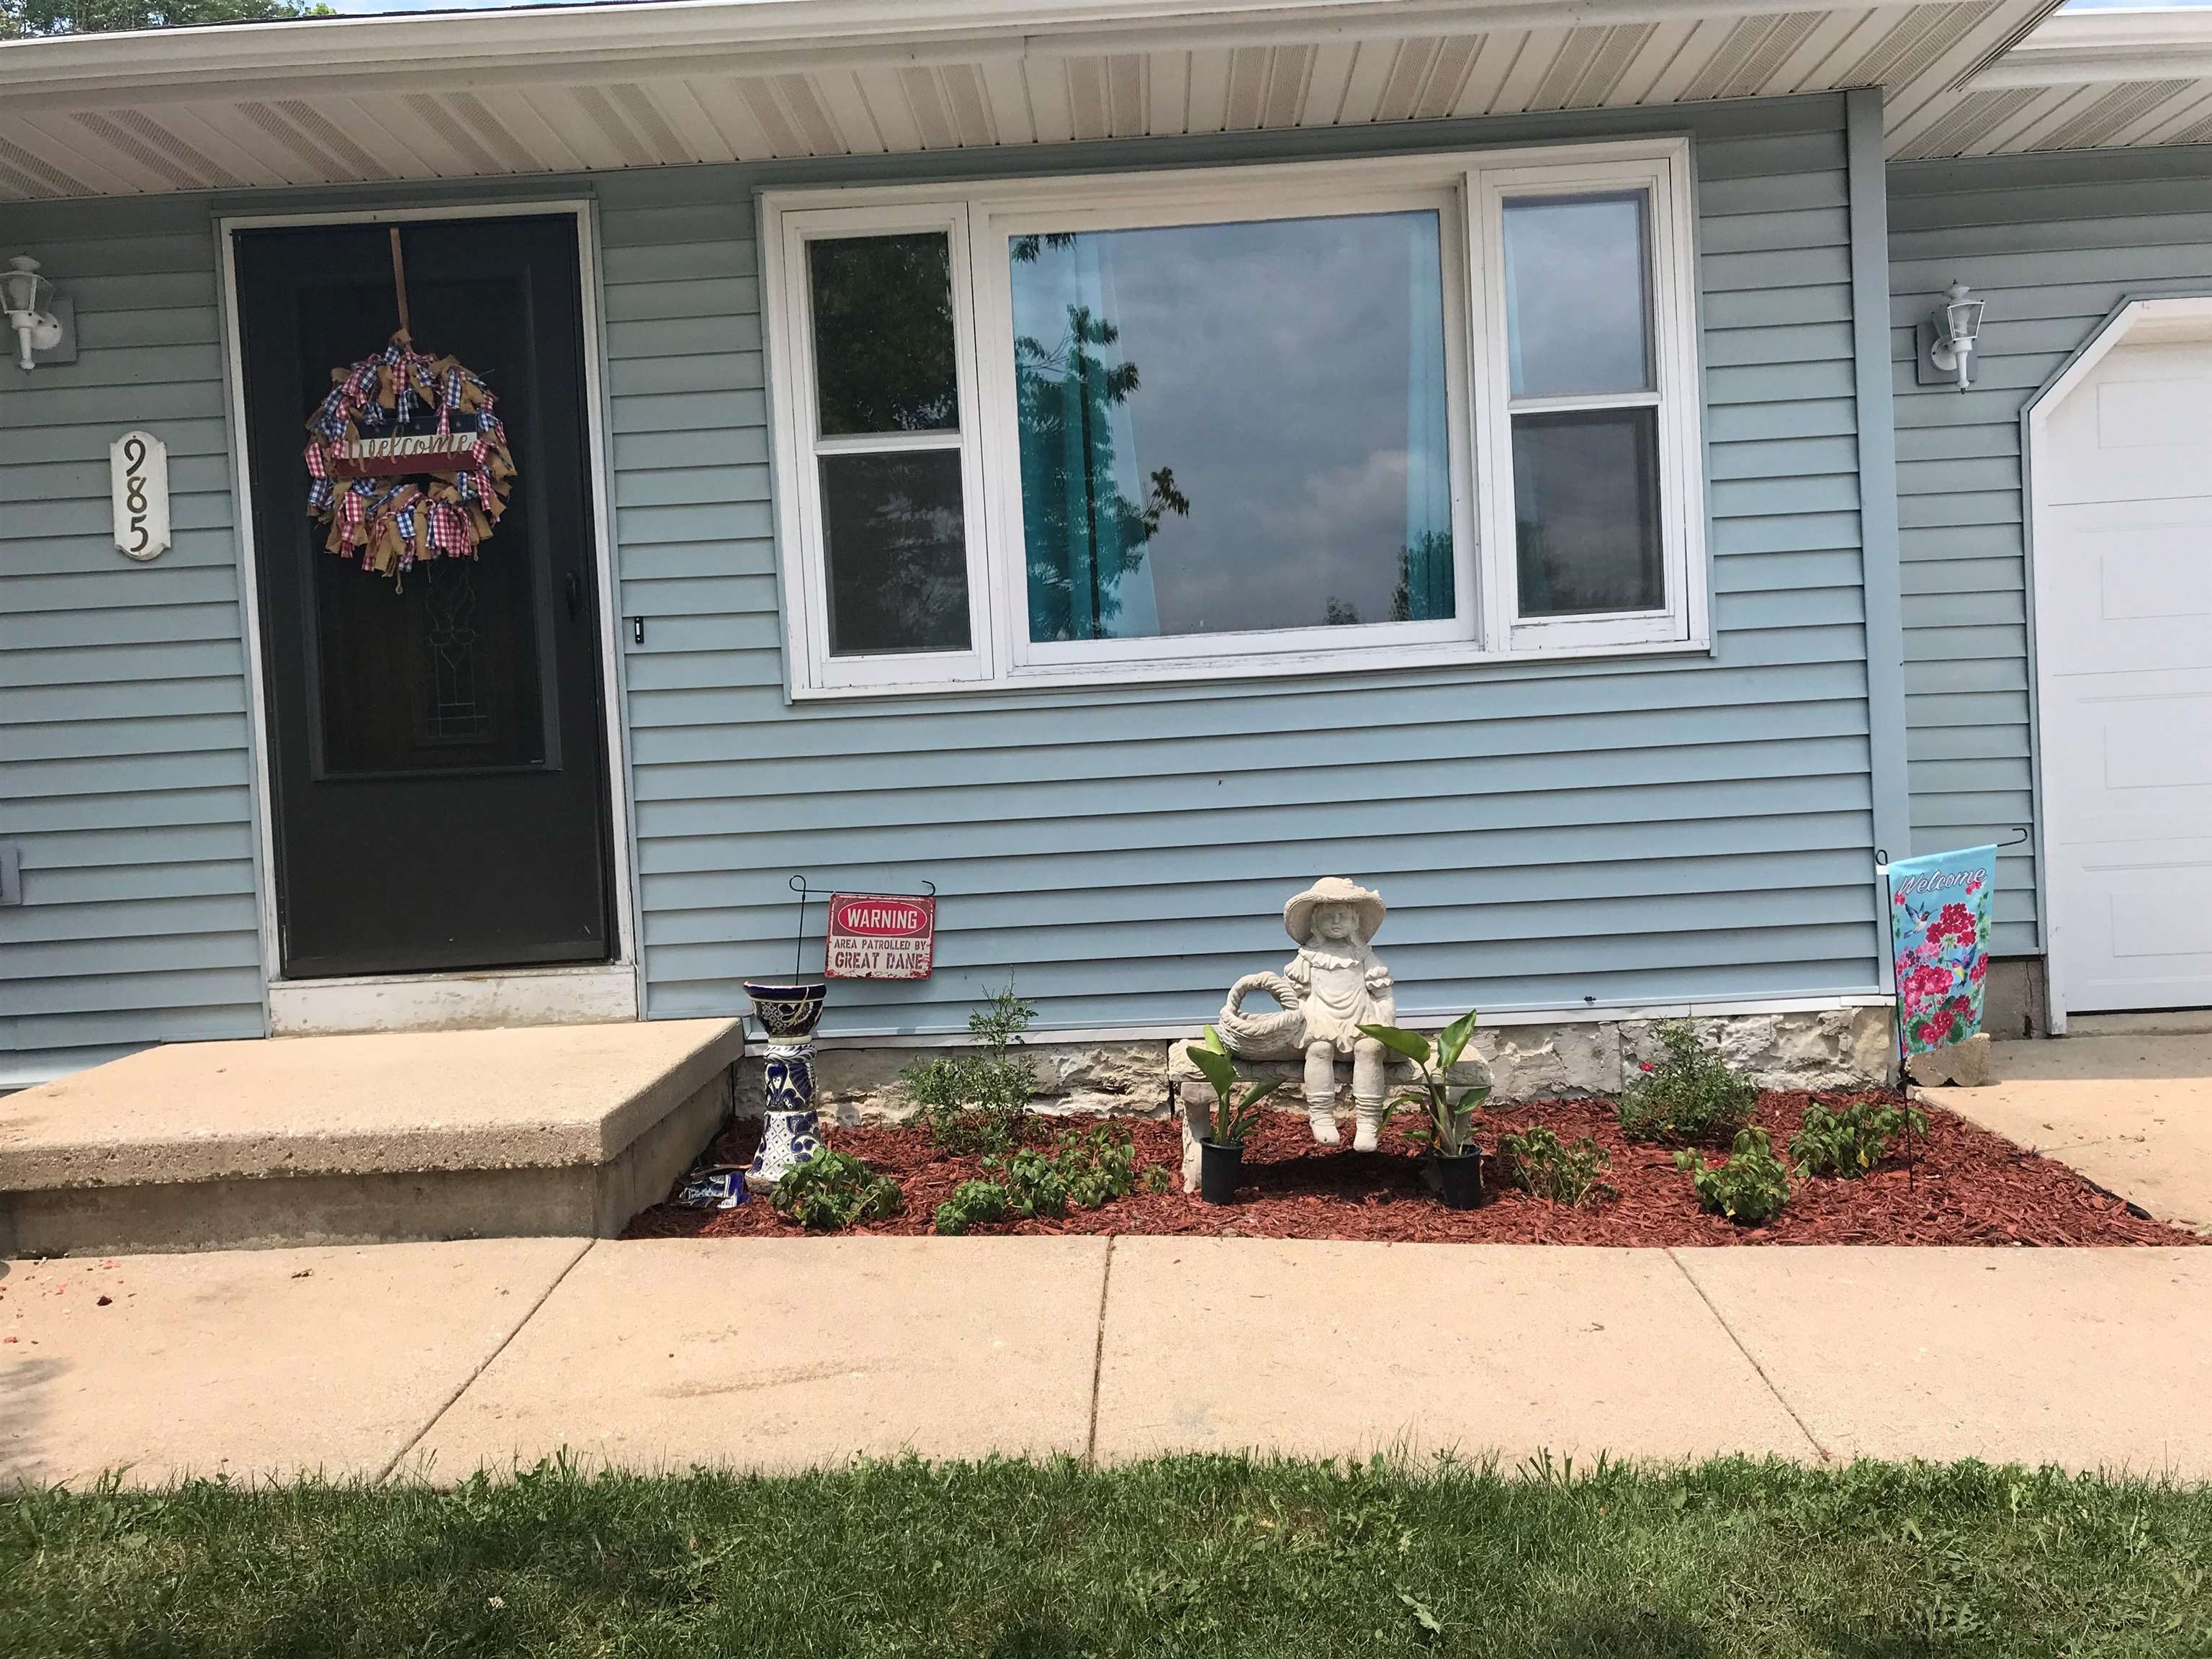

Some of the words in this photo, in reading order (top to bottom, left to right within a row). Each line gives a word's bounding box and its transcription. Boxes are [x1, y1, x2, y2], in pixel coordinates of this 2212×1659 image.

[124, 438, 149, 552] 985
[1898, 868, 1988, 896] Welcome
[848, 909, 917, 929] WARNING
[834, 939, 858, 949] AREA
[862, 939, 911, 950] PATROLLED
[914, 940, 927, 951] BY
[835, 951, 880, 969] GREAT
[886, 953, 923, 970] DANE
